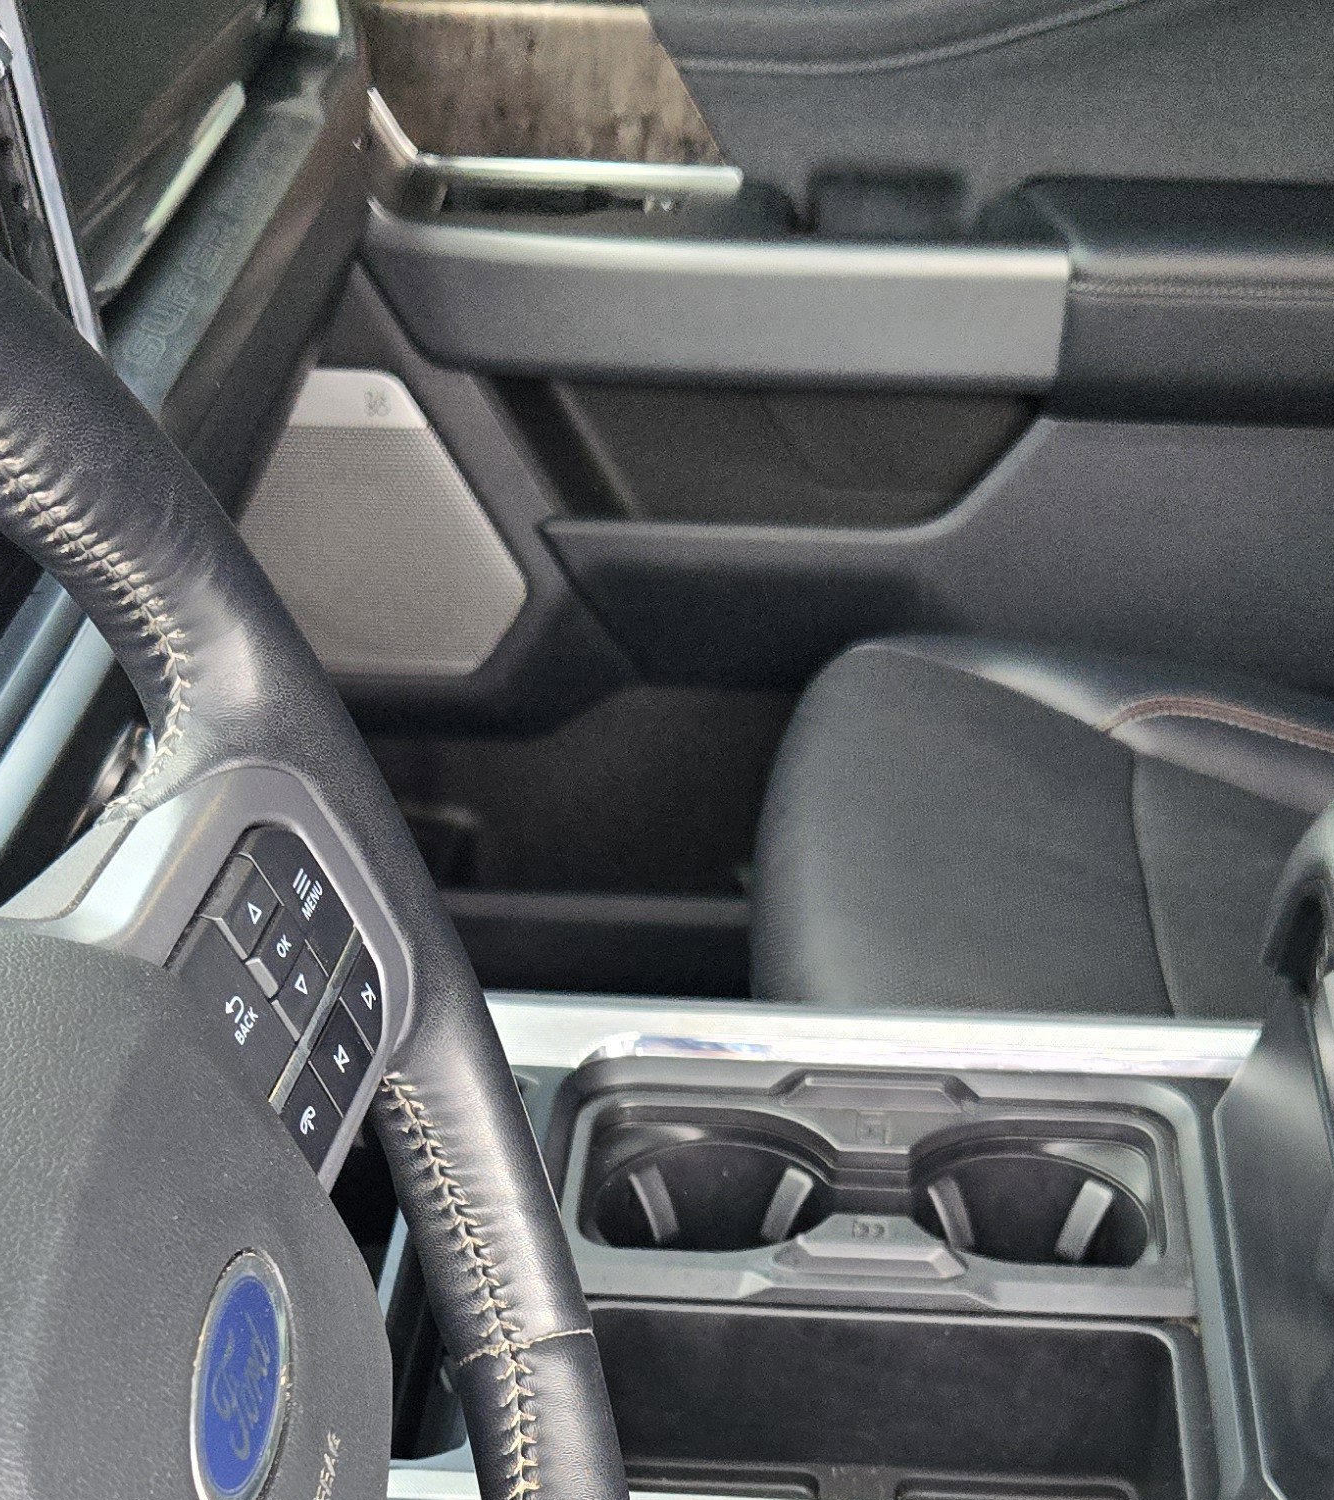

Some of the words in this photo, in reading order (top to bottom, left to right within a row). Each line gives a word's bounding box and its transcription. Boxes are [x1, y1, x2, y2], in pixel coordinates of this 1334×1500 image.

[301, 880, 323, 921] MENU
[276, 934, 292, 958] OK
[234, 1006, 259, 1046] BACK
[212, 1312, 271, 1461] Ford
